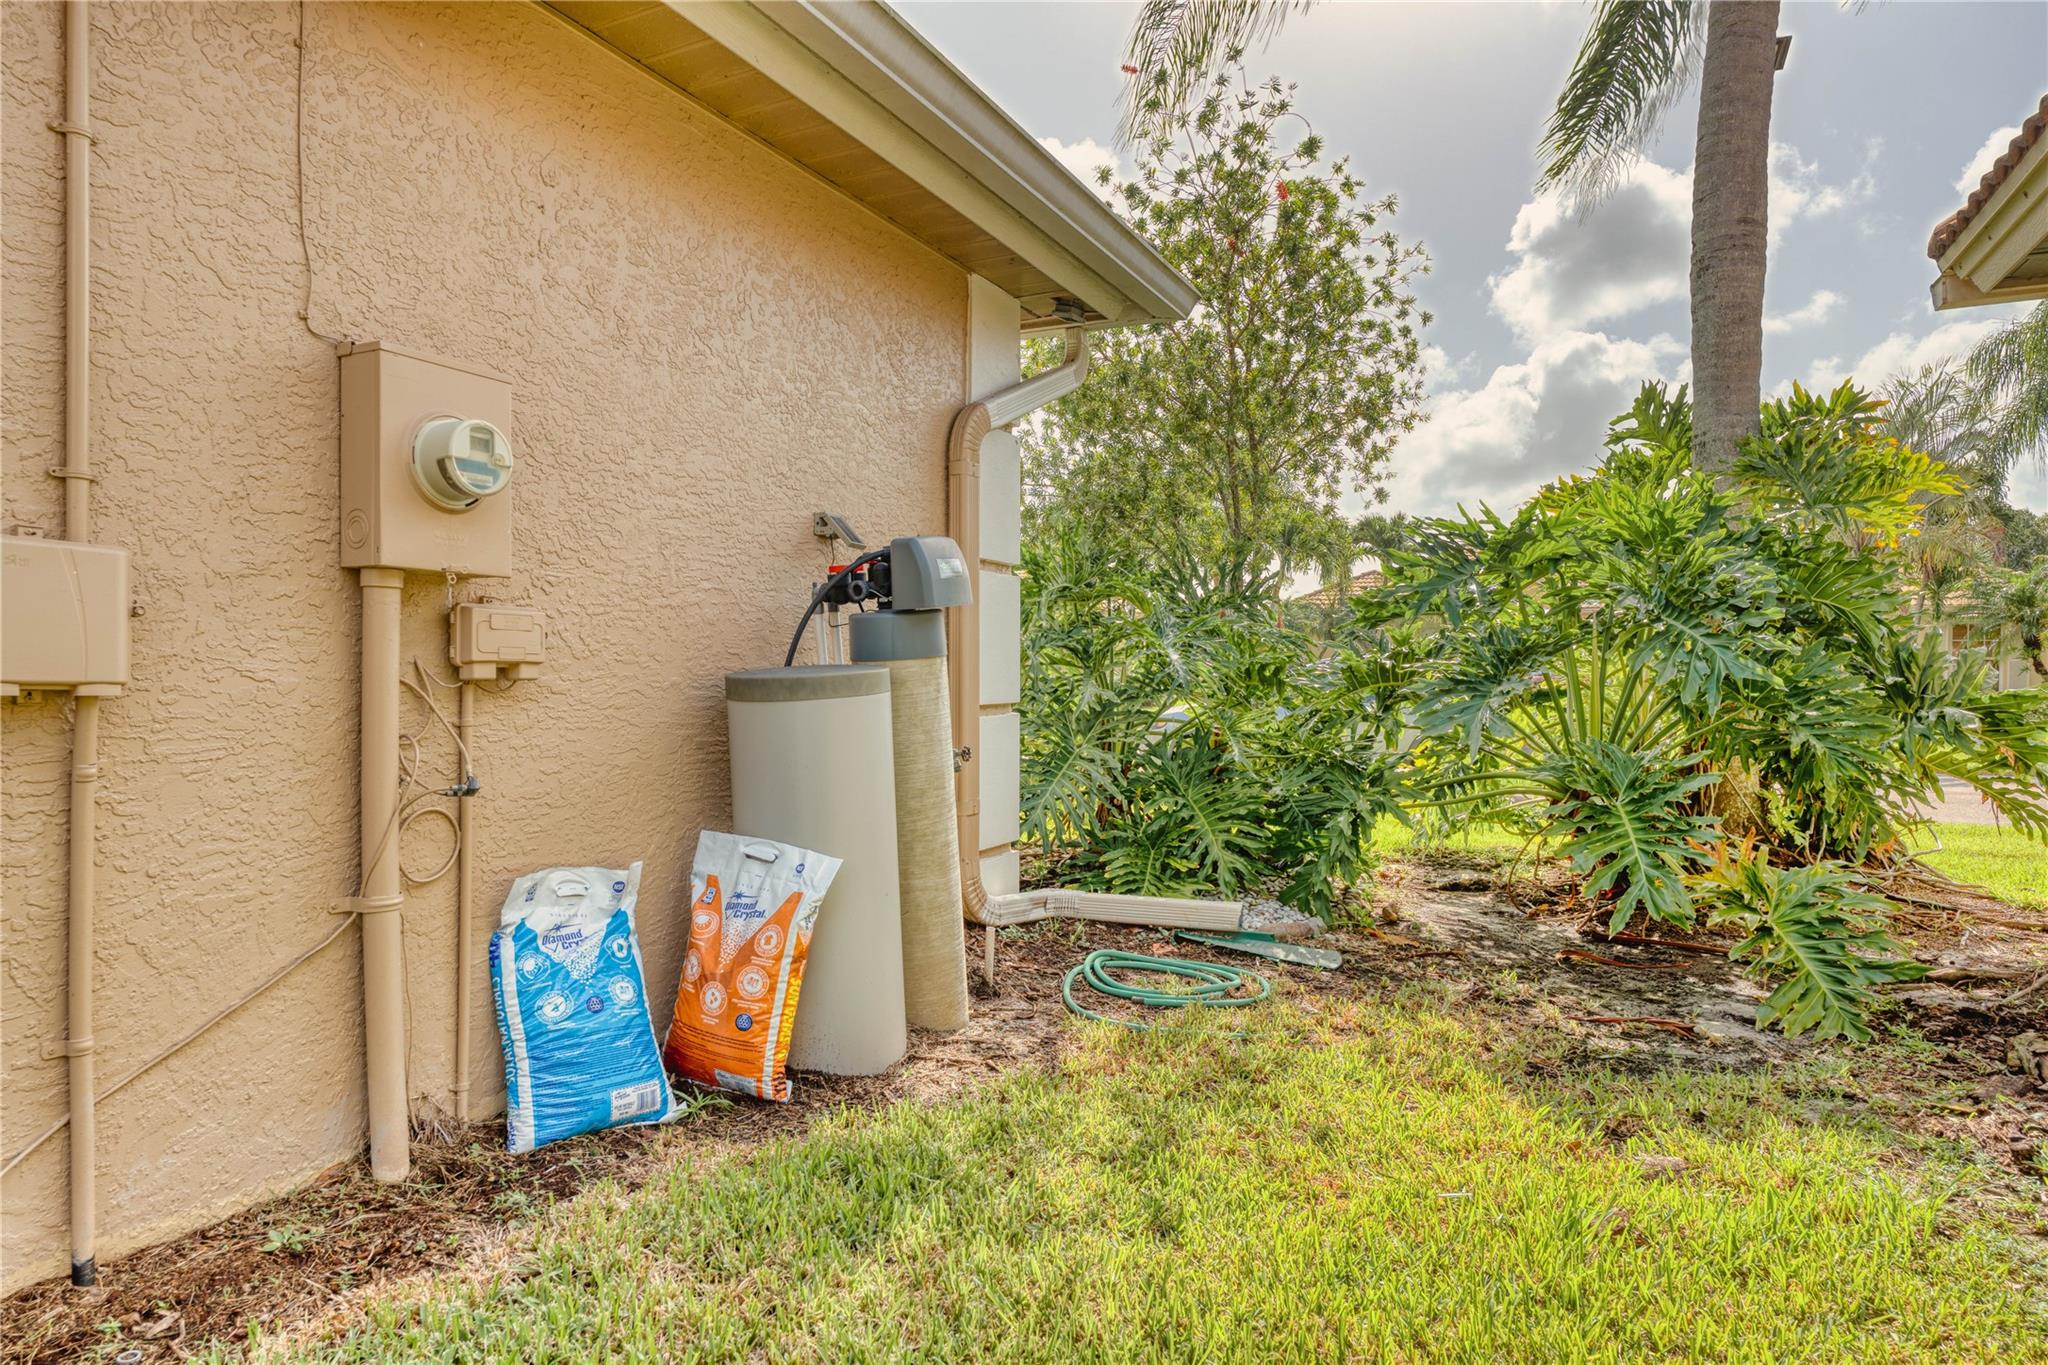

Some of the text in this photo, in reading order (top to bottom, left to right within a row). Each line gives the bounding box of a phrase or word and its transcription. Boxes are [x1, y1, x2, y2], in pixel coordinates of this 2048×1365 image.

[725, 900, 758, 911] Damond
[733, 909, 766, 921] Crystal
[542, 929, 583, 945] Diamond
